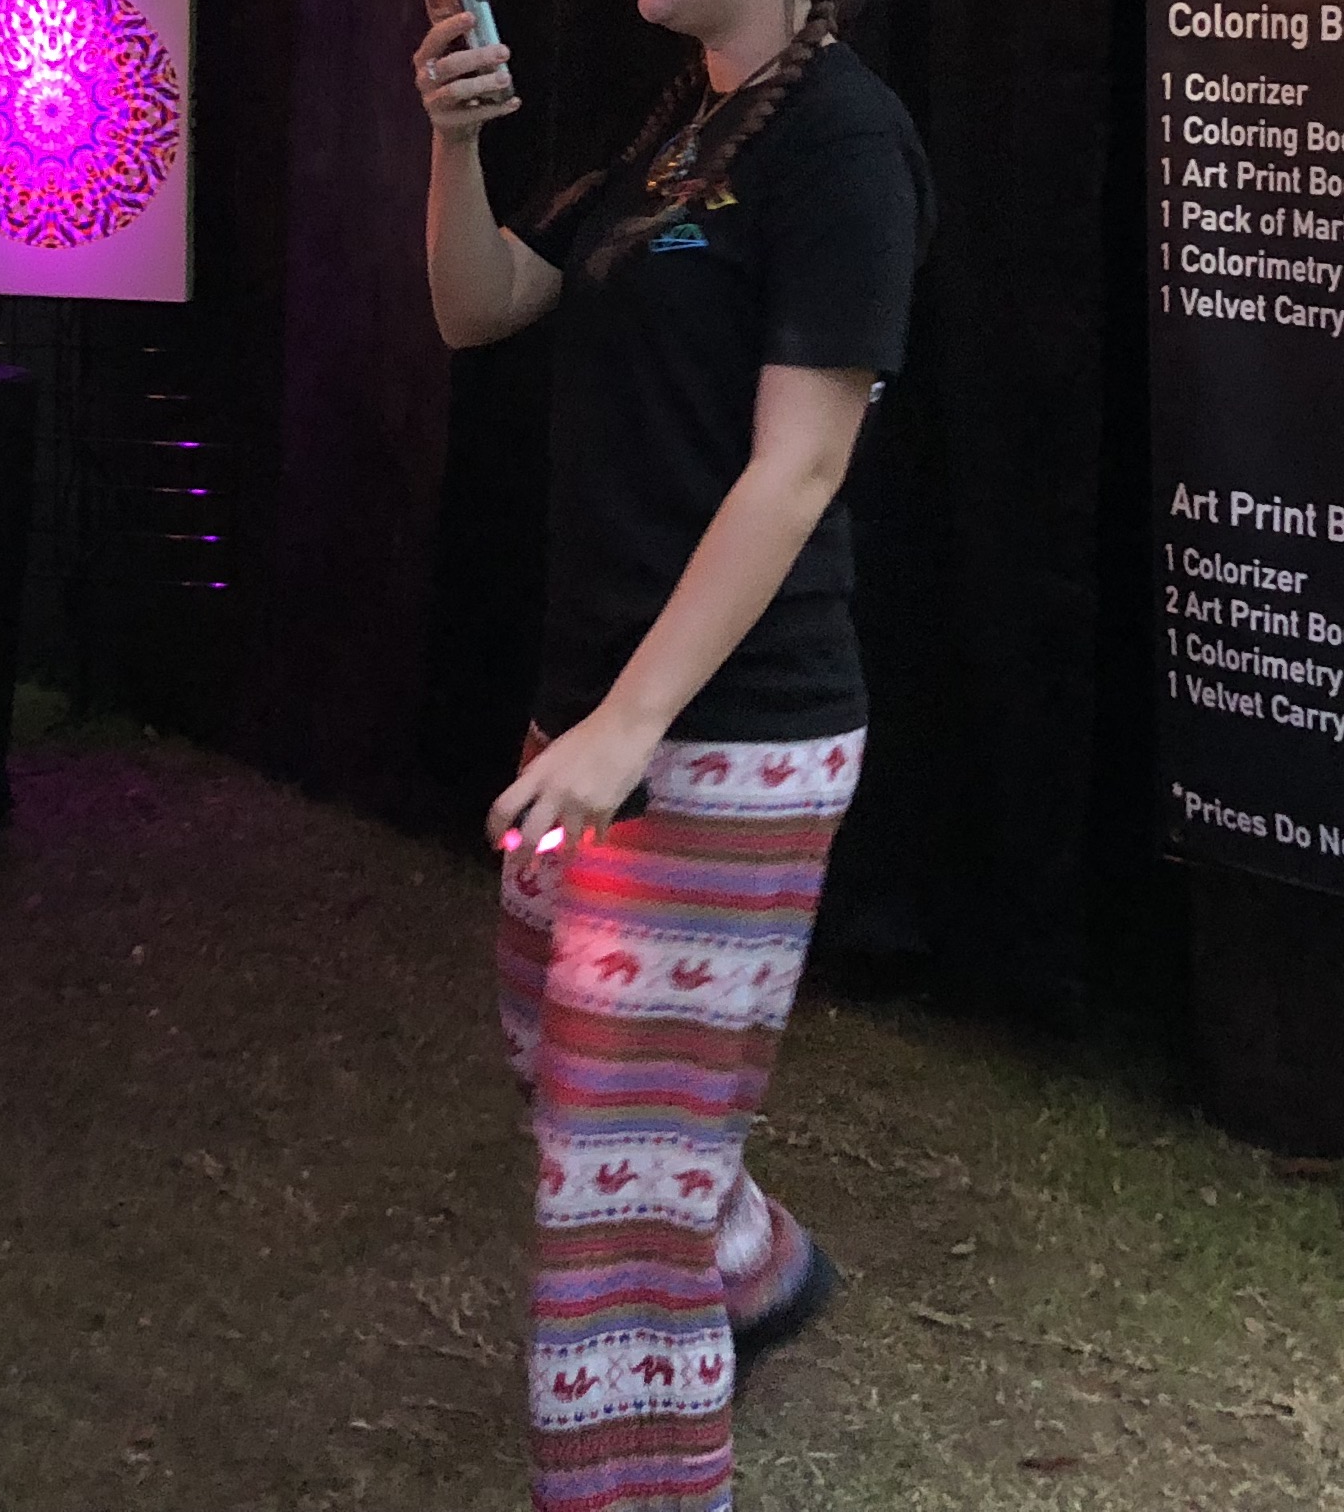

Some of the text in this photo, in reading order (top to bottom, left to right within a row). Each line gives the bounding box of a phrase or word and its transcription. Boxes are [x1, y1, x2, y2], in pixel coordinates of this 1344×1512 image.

[1168, 2, 1309, 50] Coloring
[1162, 72, 1309, 106] 1 Colorizer
[1161, 114, 1171, 142] 1
[1183, 115, 1298, 157] Coloring
[1161, 157, 1170, 185] 1
[1182, 158, 1229, 189] Art
[1237, 161, 1302, 194] Print
[1161, 200, 1170, 227] 1
[1182, 201, 1252, 234] Pack
[1260, 207, 1286, 236] of
[1161, 242, 1169, 270] 1
[1181, 244, 1343, 293] Colorimetry
[1161, 285, 1170, 313] 1
[1179, 287, 1267, 322] Velvet
[1170, 482, 1219, 523] Art
[1230, 491, 1317, 537] Print
[1165, 543, 1308, 594] 1 Colorizer
[1165, 585, 1179, 614] 2
[1184, 591, 1223, 625] Art
[1230, 599, 1300, 638] Print
[1167, 628, 1177, 656] 1
[1186, 633, 1344, 698] Colorimetry
[1168, 670, 1177, 698] 1
[1186, 674, 1265, 719] Velvet
[1274, 813, 1311, 848] Do
